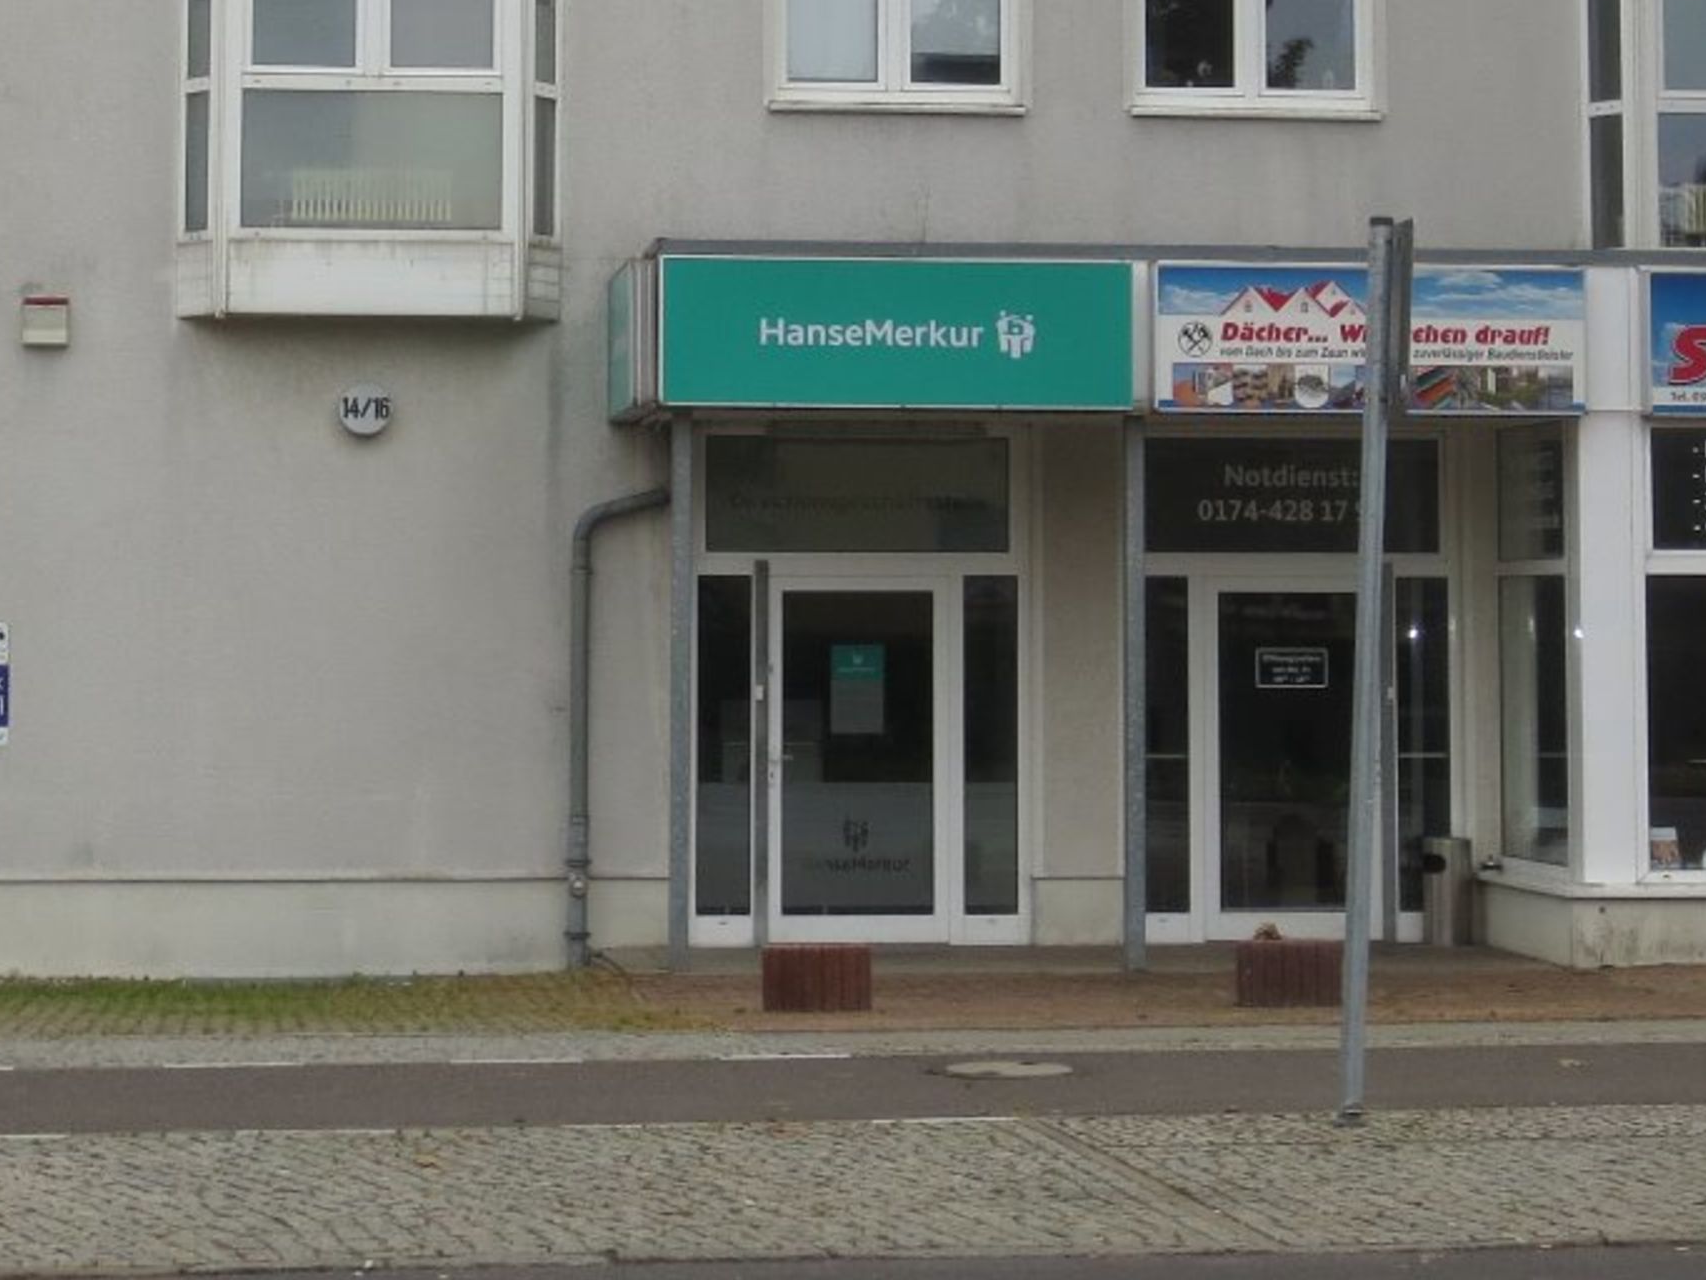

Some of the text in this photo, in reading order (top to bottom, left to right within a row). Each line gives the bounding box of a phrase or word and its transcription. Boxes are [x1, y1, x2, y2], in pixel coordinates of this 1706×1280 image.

[759, 317, 985, 347] HanseMerkur
[1474, 325, 1552, 346] drauf!
[343, 396, 390, 420] 14/16
[1223, 464, 1360, 488] Notdienst:
[1197, 499, 1314, 522] 0174-428
[1322, 500, 1347, 521] 17
